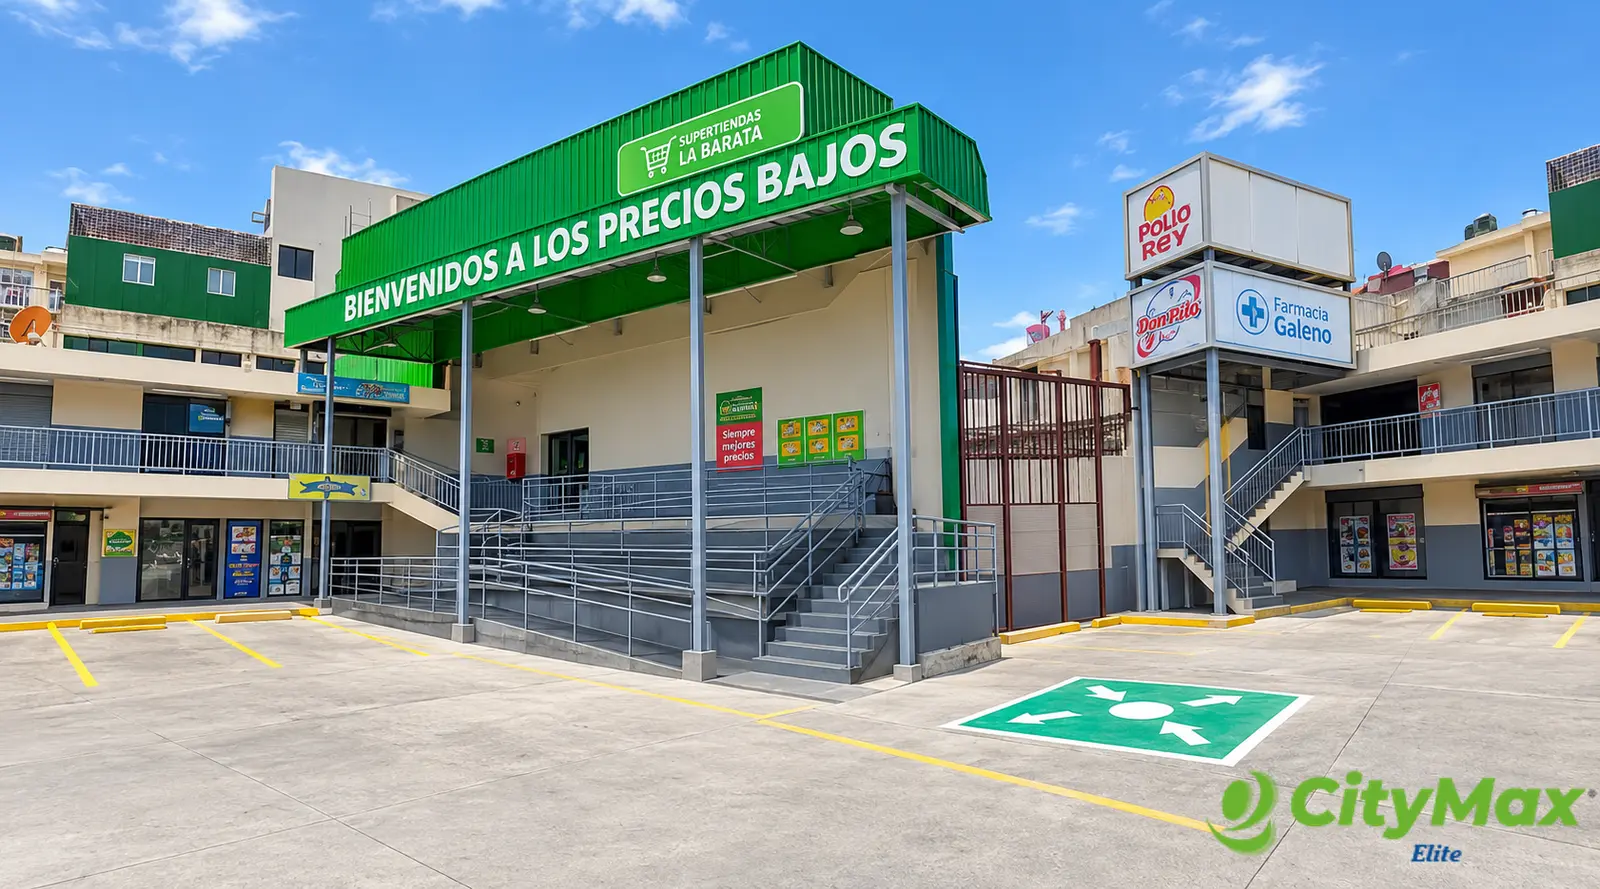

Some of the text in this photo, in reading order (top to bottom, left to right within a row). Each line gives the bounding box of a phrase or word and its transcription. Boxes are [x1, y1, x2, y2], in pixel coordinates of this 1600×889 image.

[679, 108, 761, 147] SUPERTIENDAS
[679, 125, 763, 166] LA BARATA
[344, 122, 907, 322] BIENVENIDOS A LOS PRECIOS BAJOS
[1138, 204, 1191, 243] POLLO
[1274, 296, 1329, 322] Farmacia
[1136, 315, 1167, 335] Don
[1274, 315, 1332, 344] Galeno
[722, 428, 756, 440] Siempre
[722, 440, 756, 452] mejores
[723, 451, 755, 464] precios
